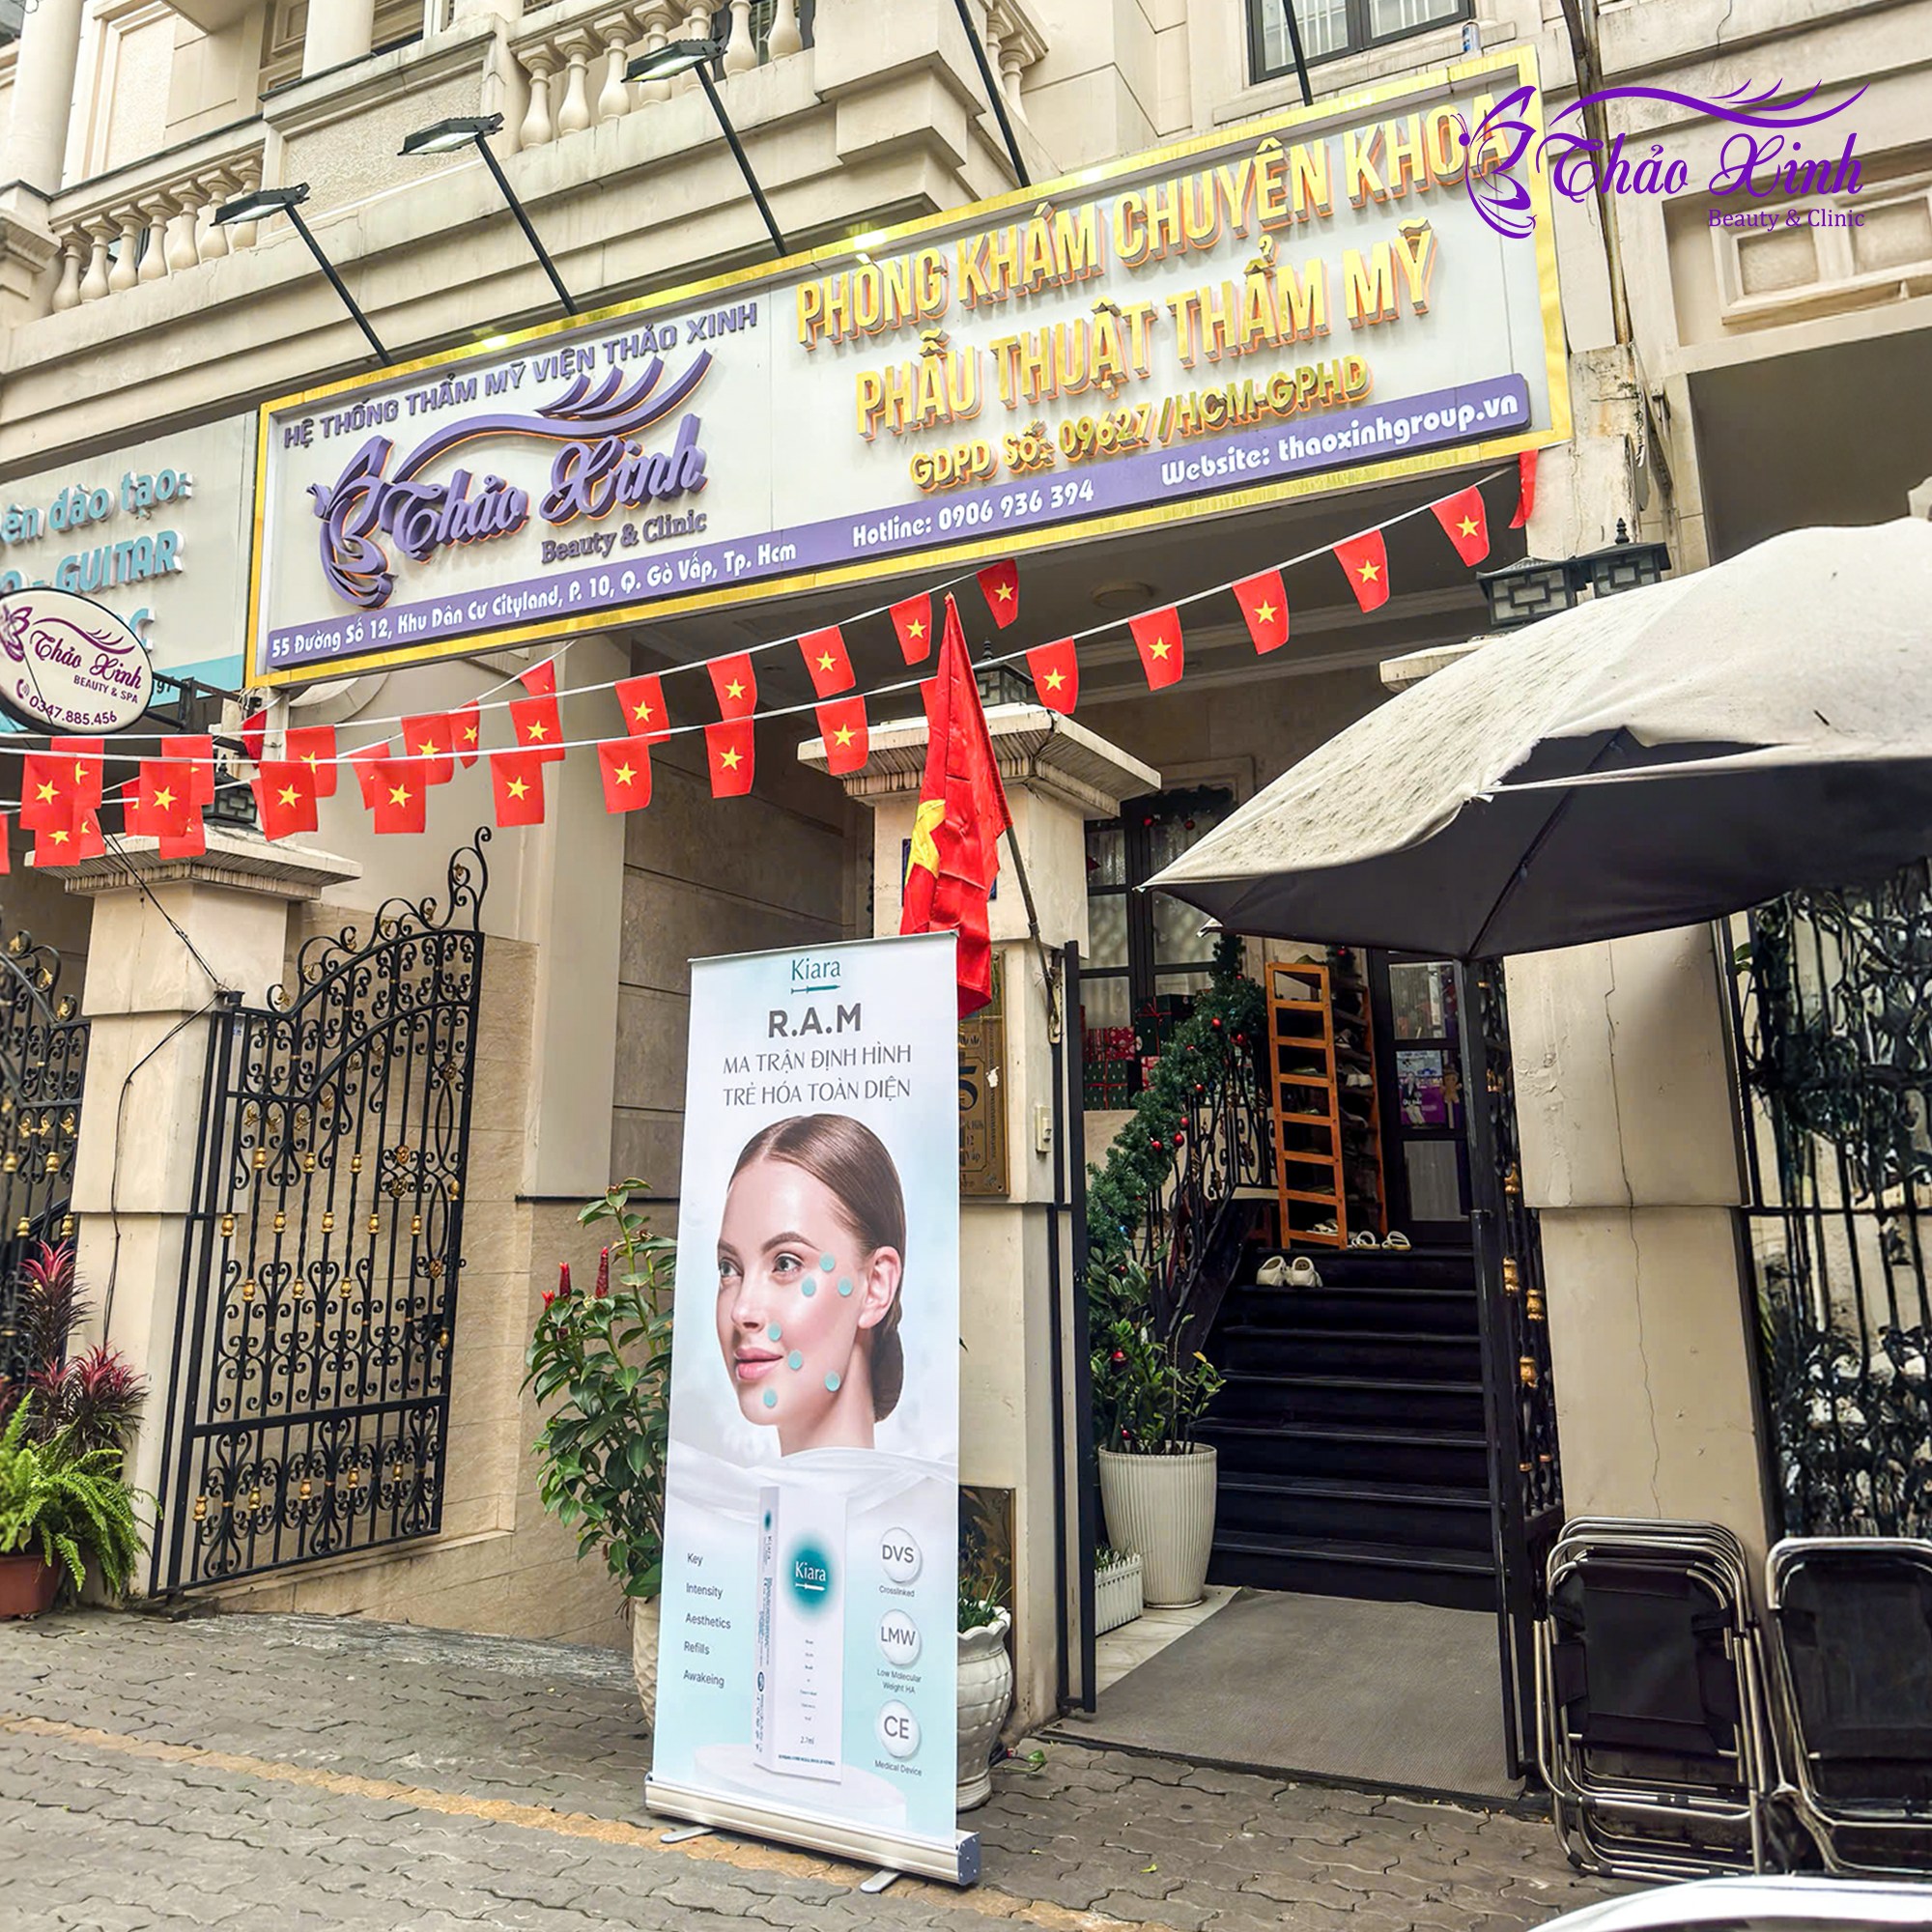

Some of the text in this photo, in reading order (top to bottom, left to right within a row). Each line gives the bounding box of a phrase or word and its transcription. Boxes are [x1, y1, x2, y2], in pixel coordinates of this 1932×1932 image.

[796, 93, 1515, 350] PHÒNG KHÁM CHUYÊN KHOA
[856, 216, 1436, 440] PHẪU THUẬT THẨM MỸ
[284, 302, 757, 448] HỆ THỐNG THẨM MỸ VIỆN THẢO XINH
[1161, 394, 1519, 486] Website: thaoxinhgroup.vn
[909, 439, 998, 492] GDPD
[49, 483, 114, 532] đào
[121, 469, 192, 519] tạo:
[380, 412, 709, 564] Thảo Xinh
[853, 479, 1094, 548] Hotline: 0906 936 394
[541, 509, 707, 563] Beauty & Clinic
[56, 529, 184, 594] GUITAR
[271, 543, 796, 658] 55 Đường Số 12, Khu Dân Cư Cityland, P. 10, Q. Gò Vấp, Tp. Hcm
[30, 630, 82, 669] Thảo
[89, 653, 142, 690] Xinh
[73, 675, 138, 704] BEAUTY & SPA
[29, 696, 118, 725] 0347.885.456
[791, 959, 841, 981] Kiara
[768, 1003, 862, 1038] R.A.M
[724, 1041, 911, 1074] MA TRẬN ĐỊNH HÌNH
[762, 1081, 803, 1104] HÓA
[808, 1077, 859, 1101] TOÀN
[865, 1075, 911, 1101] DIỆN
[687, 1552, 703, 1567] Key
[882, 1545, 915, 1564] DVS
[795, 1561, 826, 1581] Kiara
[686, 1582, 724, 1601] Intensity
[879, 1584, 915, 1598] Crosslinked
[685, 1612, 731, 1630] Aesthetics
[684, 1640, 710, 1656] Refills
[880, 1627, 916, 1646] LMW
[683, 1669, 725, 1689] Awakeing
[876, 1668, 922, 1683] Low Molecular
[882, 1681, 916, 1694] Weight HA
[883, 1716, 909, 1739] CE
[874, 1759, 922, 1777] Medical Device
